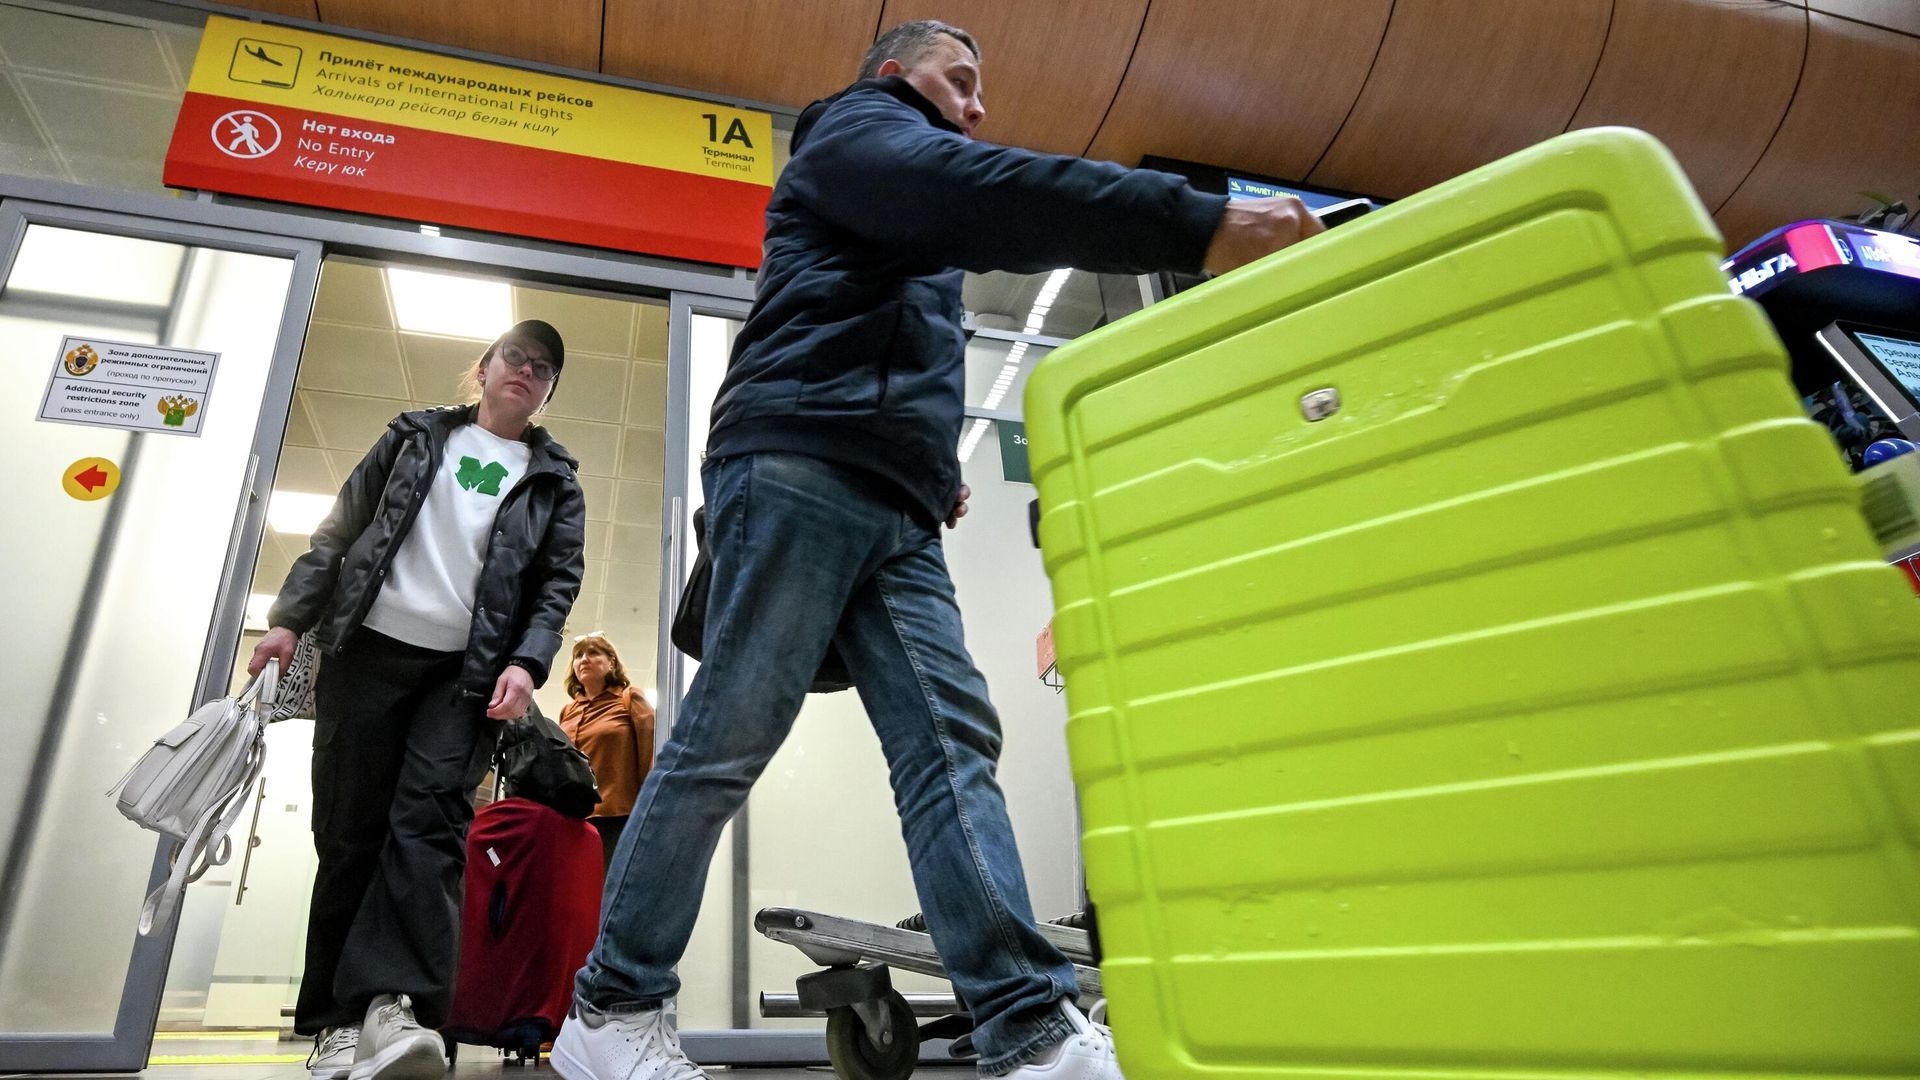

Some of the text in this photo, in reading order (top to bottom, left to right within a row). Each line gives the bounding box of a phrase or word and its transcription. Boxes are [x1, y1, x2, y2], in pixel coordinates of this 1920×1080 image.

[320, 51, 593, 108] Прилёт международных рейсов
[313, 84, 395, 107] Халыкара
[399, 102, 466, 120] рейслар
[316, 68, 573, 120] Arrivals of International Flights
[302, 119, 395, 144] Нет входа
[702, 113, 754, 149] 1A
[298, 138, 375, 162] No Entry
[702, 146, 755, 163] Терминал
[341, 165, 367, 177] юк
[704, 157, 752, 173] Terminal
[108, 349, 207, 365] Зона дополнительных
[1872, 344, 1920, 359] Преми
[101, 358, 208, 374] режимных ограничений
[106, 370, 139, 380] (проход
[152, 375, 197, 386] пропускам)
[65, 384, 147, 399] Additional security
[66, 395, 117, 405] restrictions
[60, 406, 140, 421] (pass entrance only)
